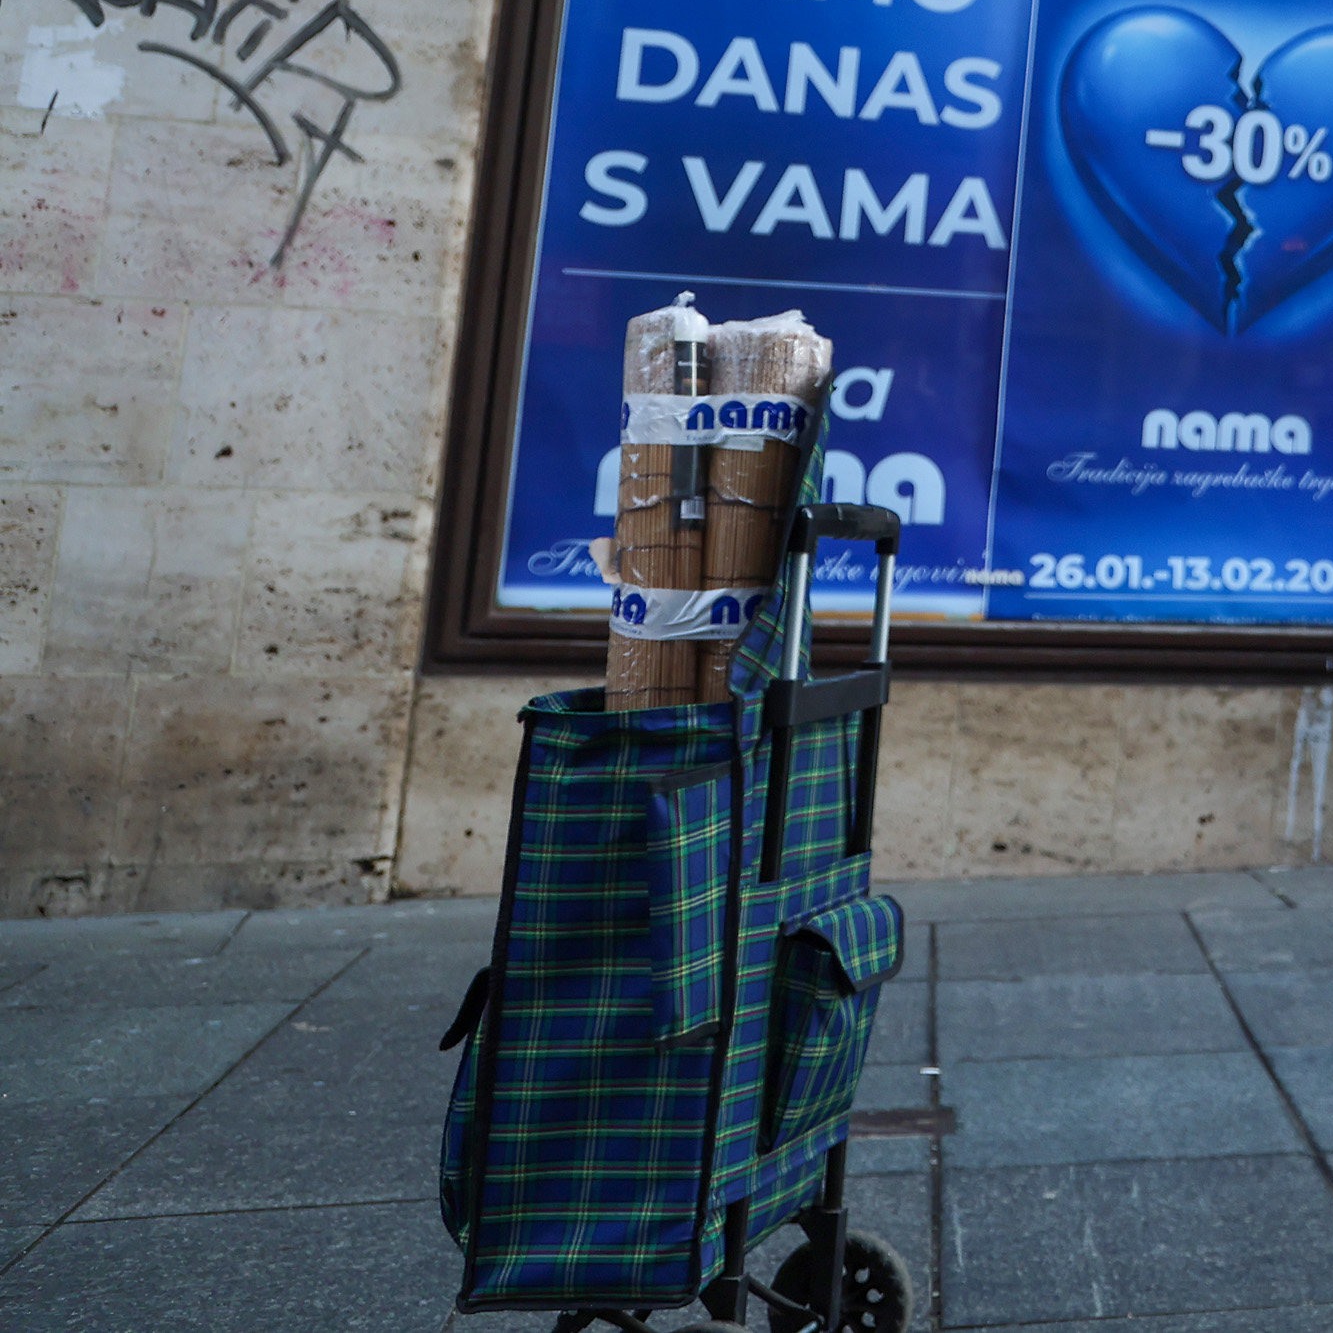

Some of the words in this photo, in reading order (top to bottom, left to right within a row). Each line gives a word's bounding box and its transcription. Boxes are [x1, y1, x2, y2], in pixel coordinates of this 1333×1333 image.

[616, 26, 1002, 129] DANAS
[1145, 104, 1333, 184] -30%
[579, 150, 649, 227] S
[682, 155, 1008, 250] VAMA
[1142, 408, 1312, 455] nama
[1046, 451, 1167, 496] Tradicija
[1170, 463, 1293, 498] zagrebačke
[964, 568, 1025, 586] nama
